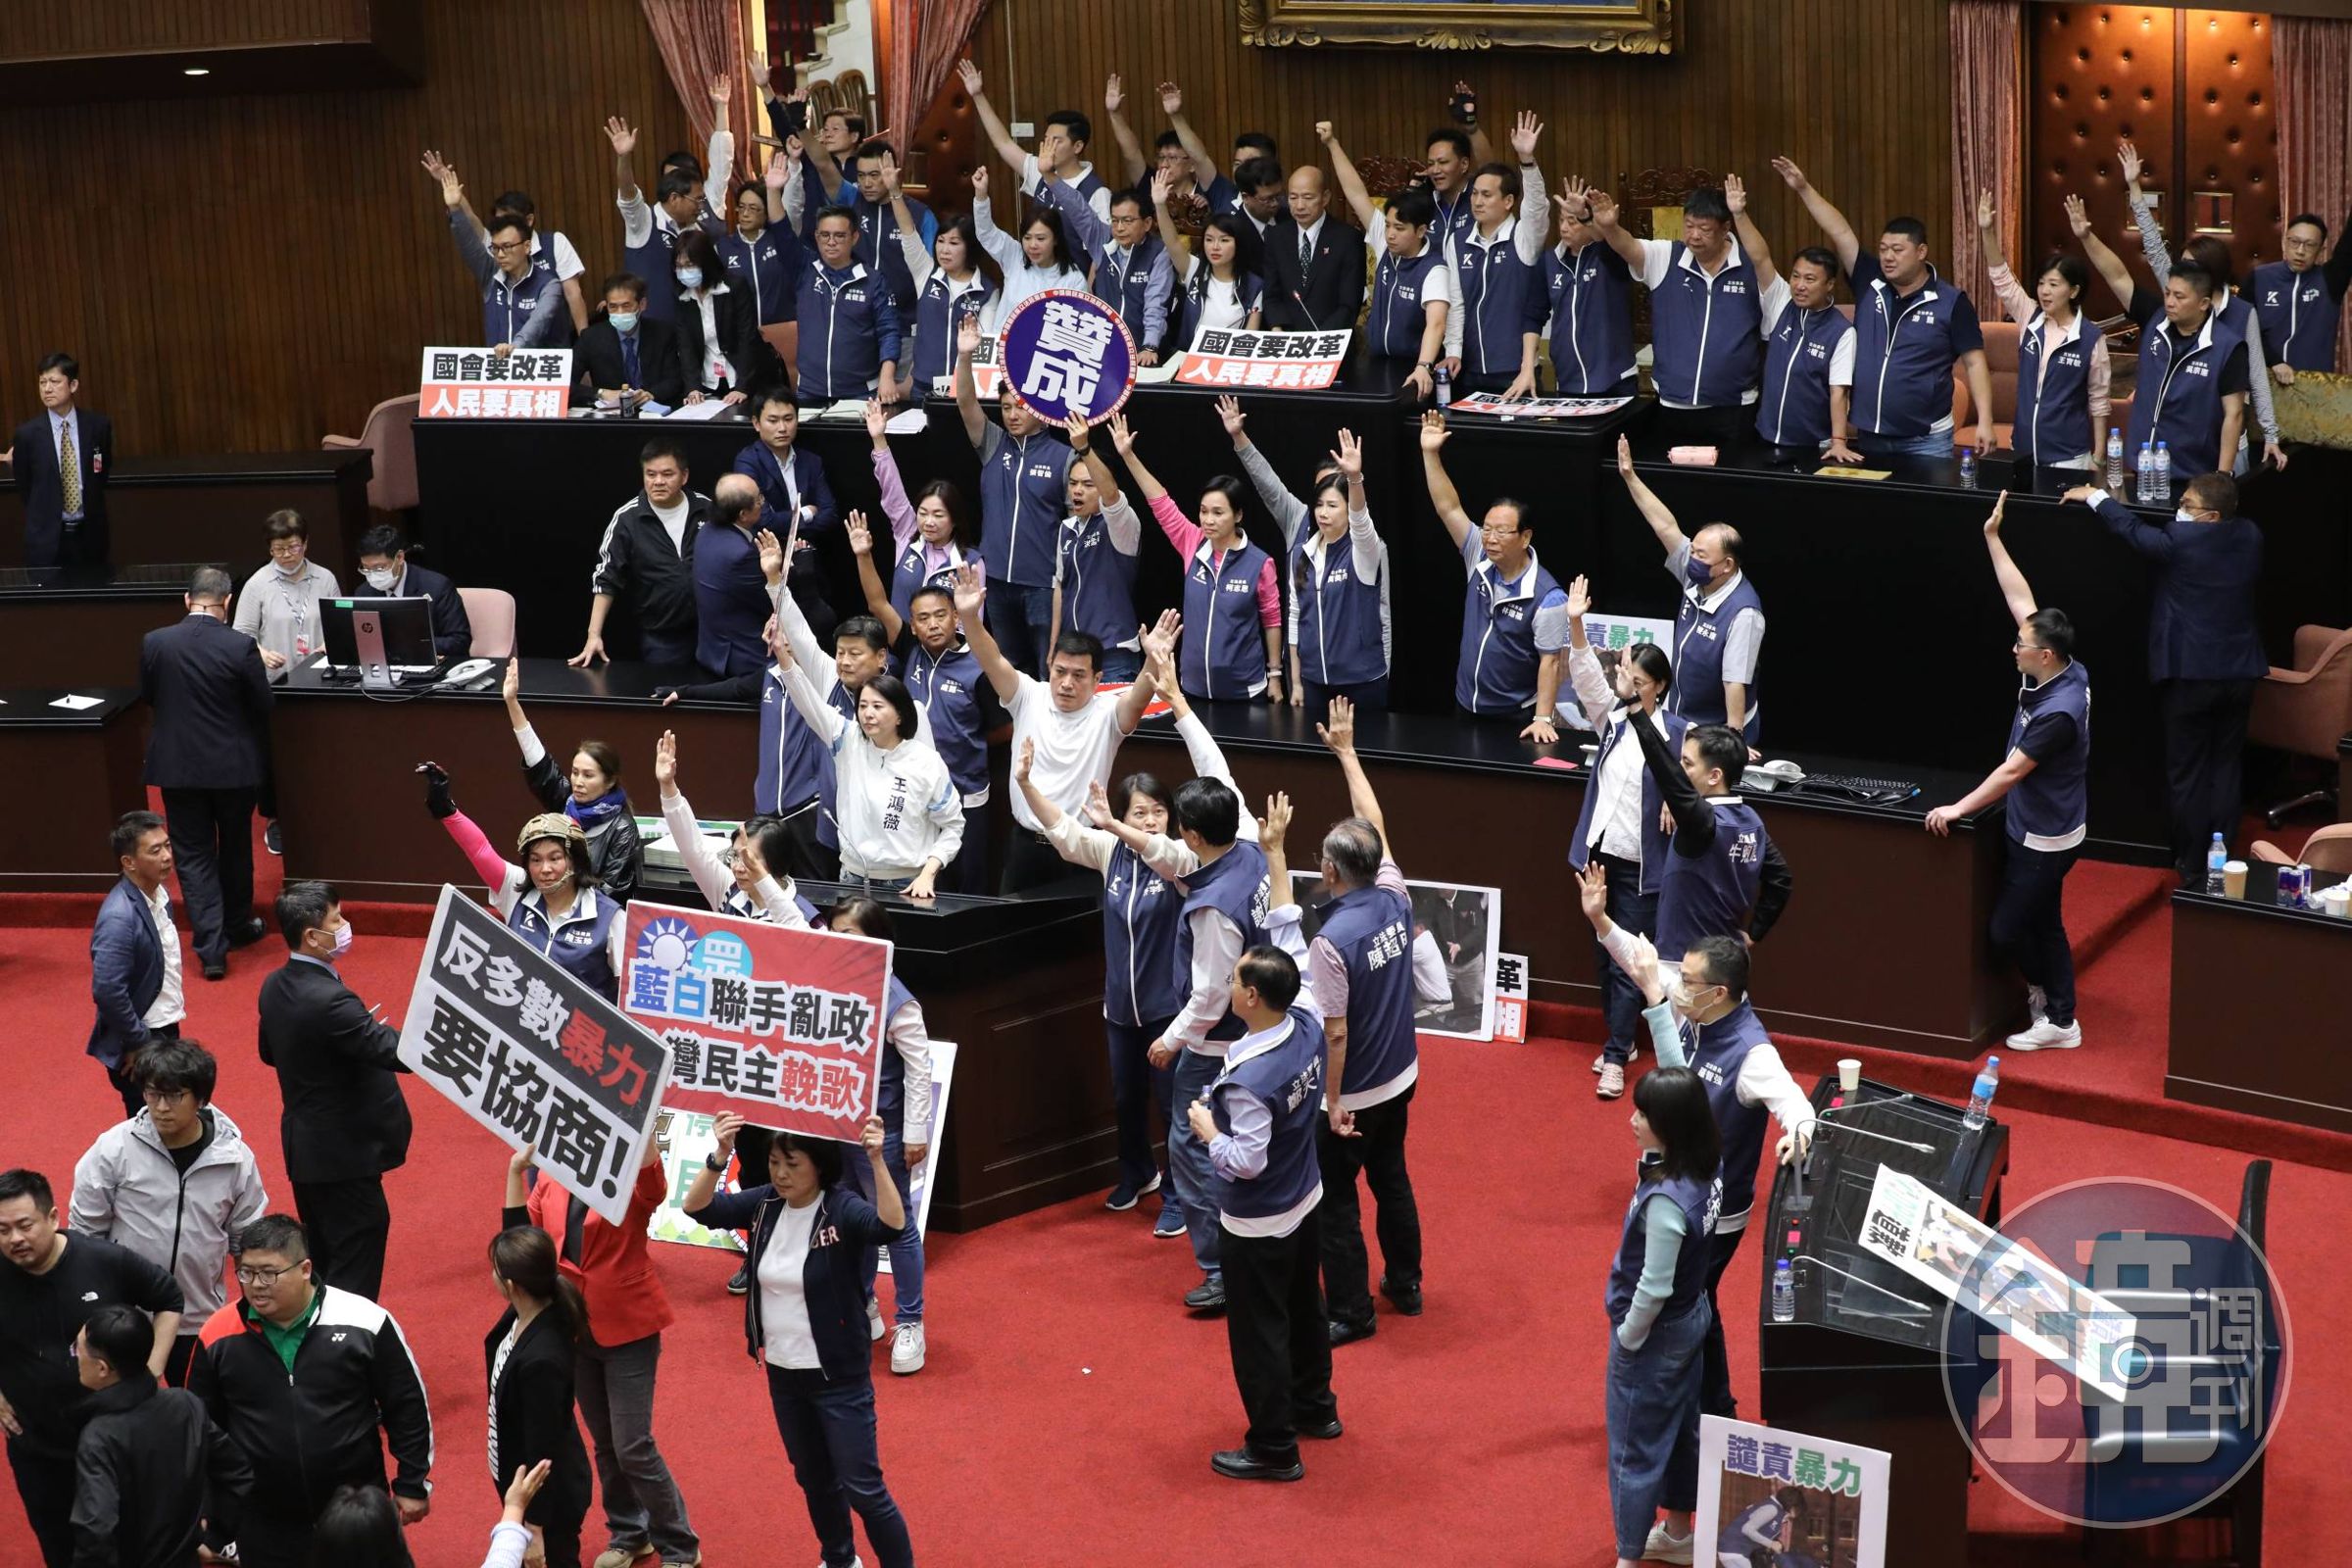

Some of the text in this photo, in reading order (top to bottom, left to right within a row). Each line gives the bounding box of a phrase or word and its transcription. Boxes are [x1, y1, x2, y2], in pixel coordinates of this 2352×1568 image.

[432, 353, 564, 382] 國會要改革
[1020, 300, 1113, 416] 贊成
[1197, 329, 1346, 359] 國會要改革
[1184, 359, 1335, 387] 人民要真相
[429, 388, 562, 417] 人民要真相
[883, 775, 907, 831] 王鴻薇
[440, 919, 649, 1106] 反多數暴力
[632, 961, 870, 1047] 藍白聯手亂政
[1727, 1434, 1861, 1495] 譴責暴力
